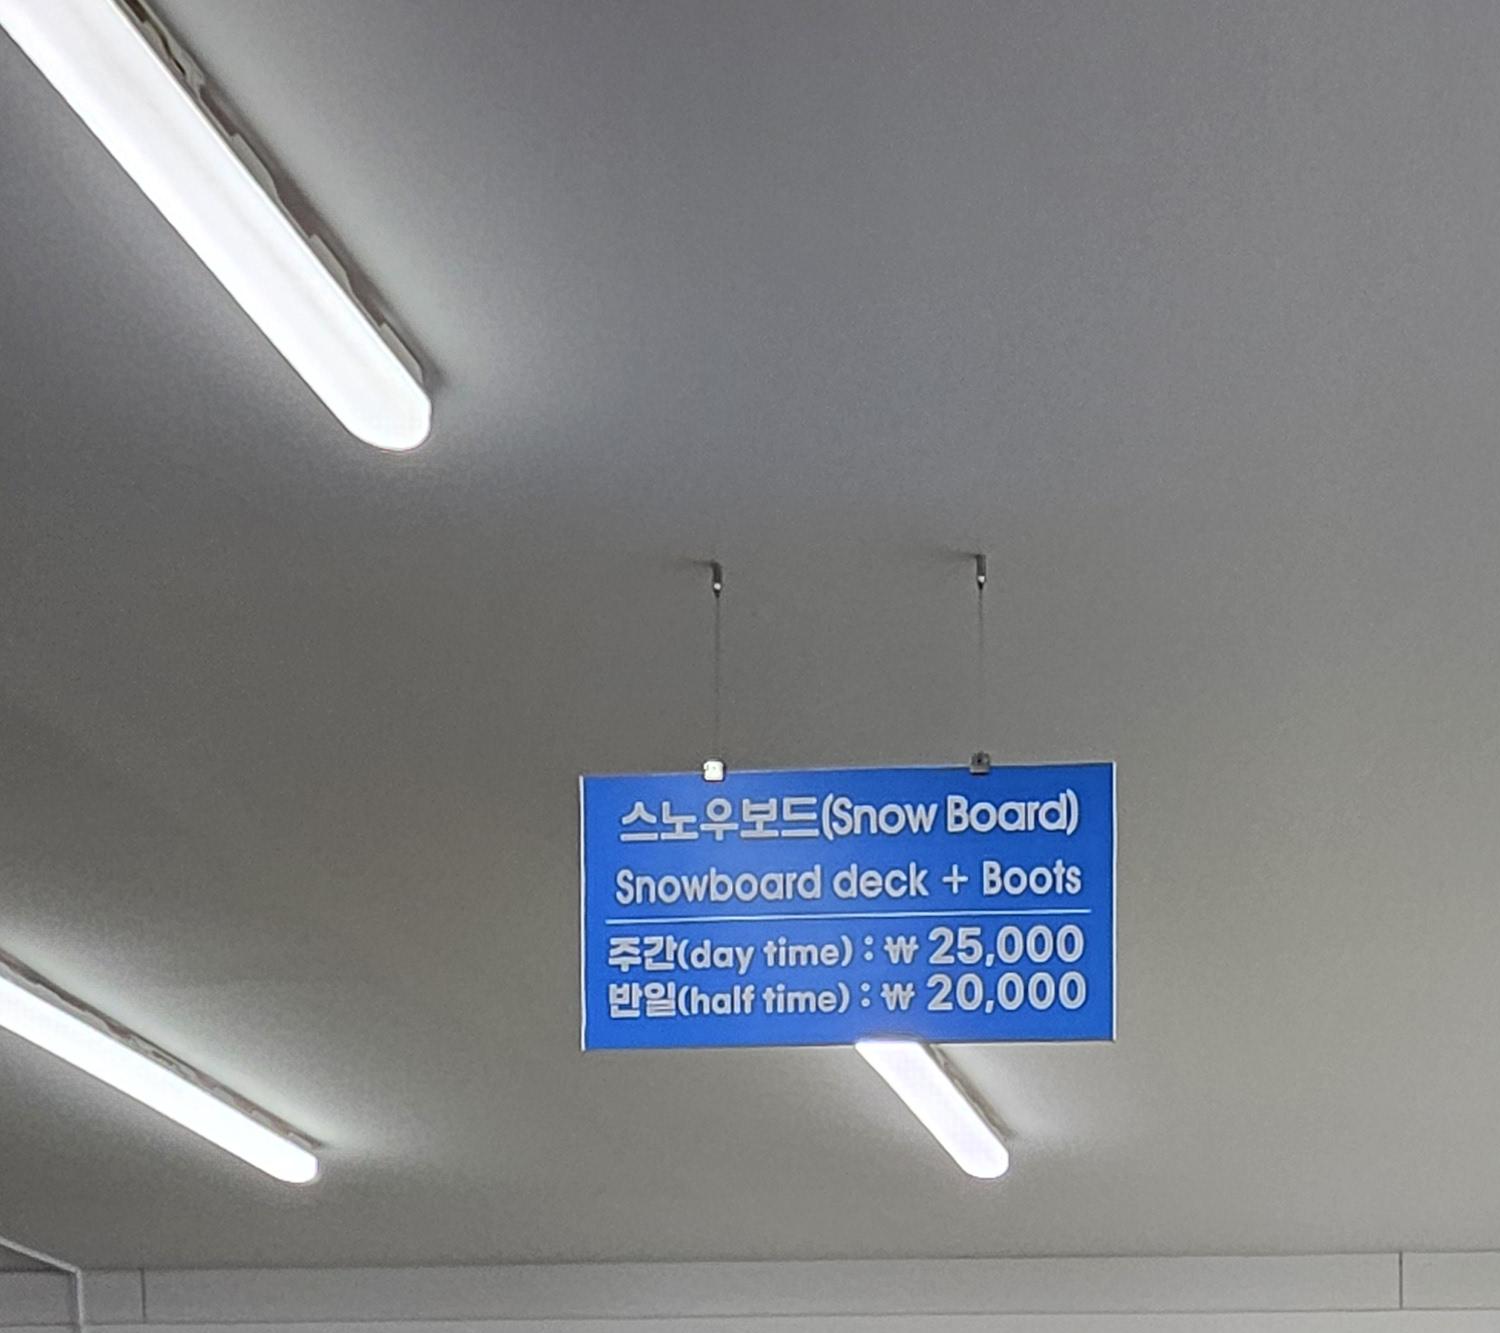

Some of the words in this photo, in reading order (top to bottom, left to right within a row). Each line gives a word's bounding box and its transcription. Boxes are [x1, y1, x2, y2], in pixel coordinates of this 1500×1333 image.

[619, 792, 939, 842] 스노우보드(Snow
[946, 788, 1079, 836] Board)
[615, 864, 822, 905] Snowboard
[832, 861, 929, 899] deck
[983, 858, 1082, 896] Boots
[608, 935, 755, 975] 주간(day
[763, 934, 853, 967] time)
[927, 924, 1085, 967] 25,000
[608, 982, 755, 1018] 반일(half
[762, 982, 850, 1014] time)
[926, 970, 1087, 1014] 20,000
